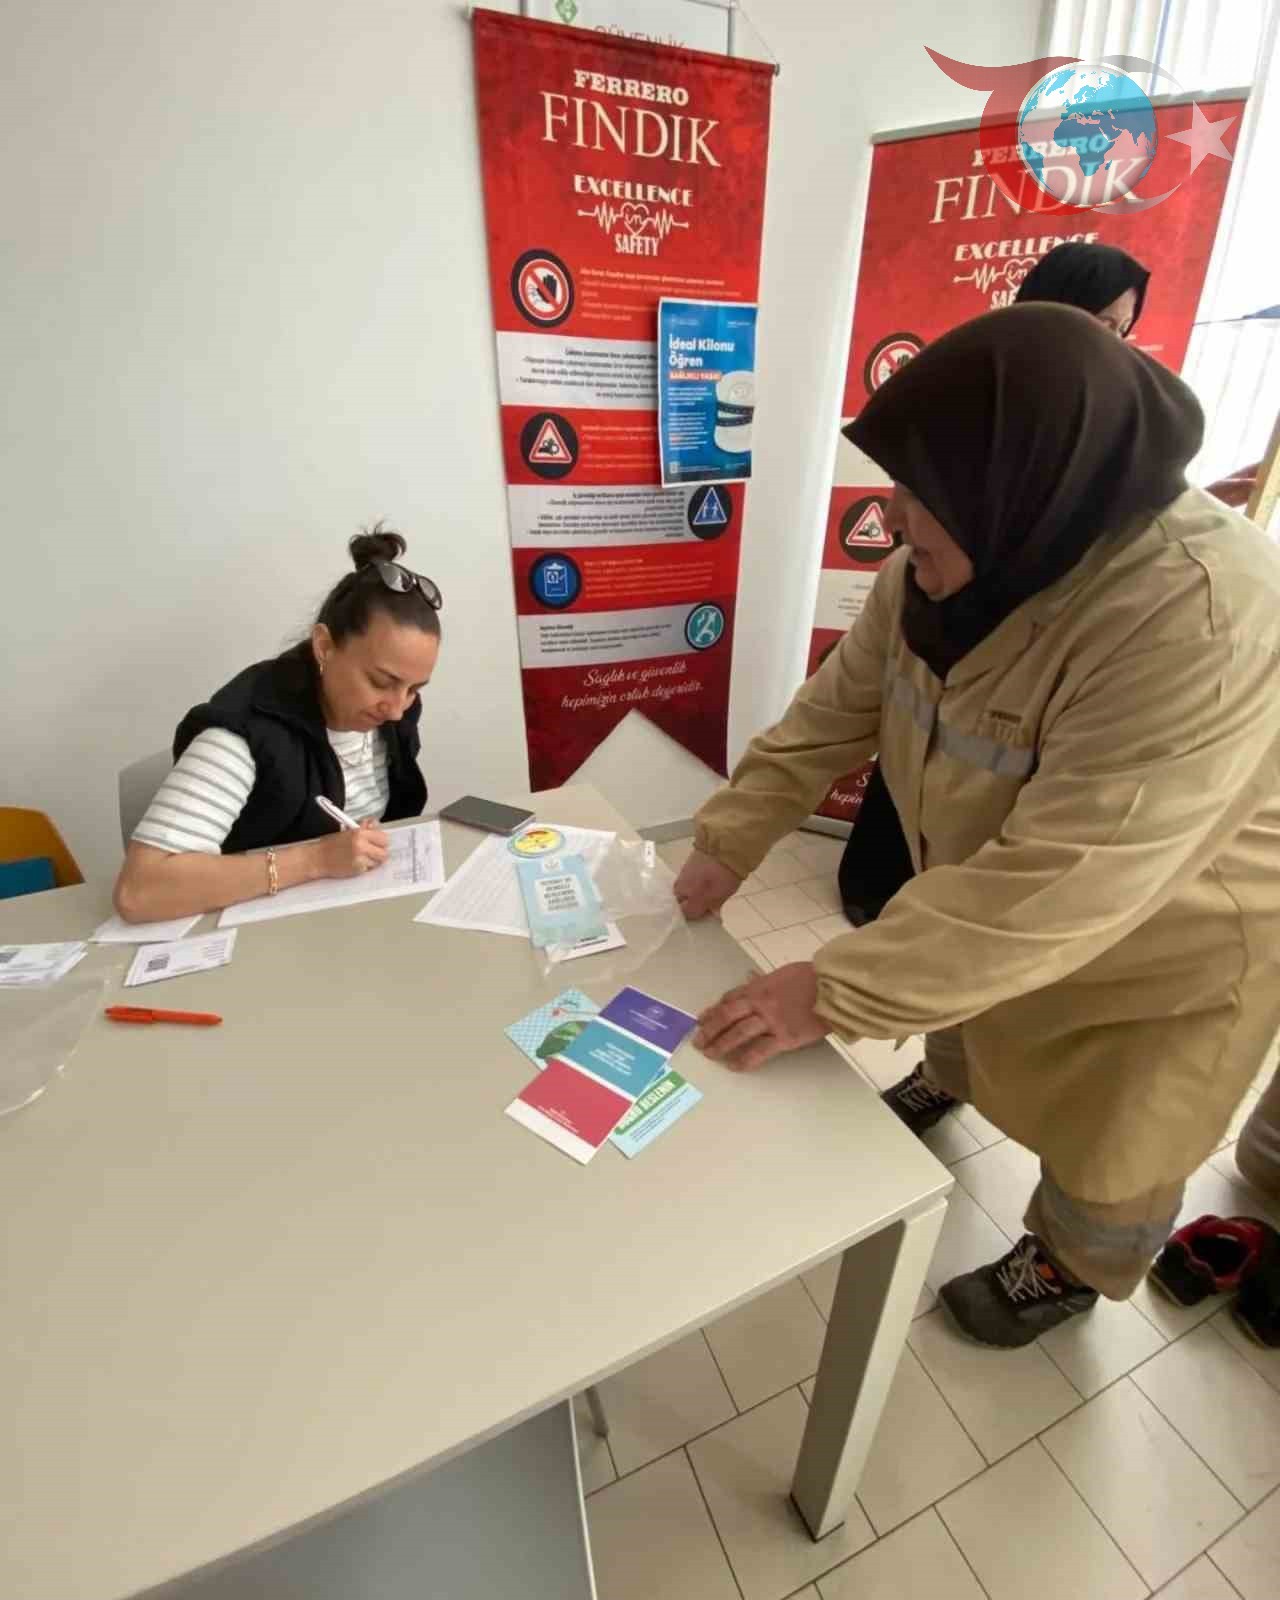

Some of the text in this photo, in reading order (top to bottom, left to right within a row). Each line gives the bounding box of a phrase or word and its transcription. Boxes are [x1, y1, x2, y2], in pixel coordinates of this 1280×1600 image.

[574, 69, 689, 106] FERRERO
[540, 91, 721, 167] FINDIK
[574, 174, 693, 207] EXCELLENCE
[929, 157, 1148, 224] FINDIK
[614, 233, 660, 256] SAFETY
[668, 350, 703, 368] Öğren
[698, 337, 735, 352] Kilonu
